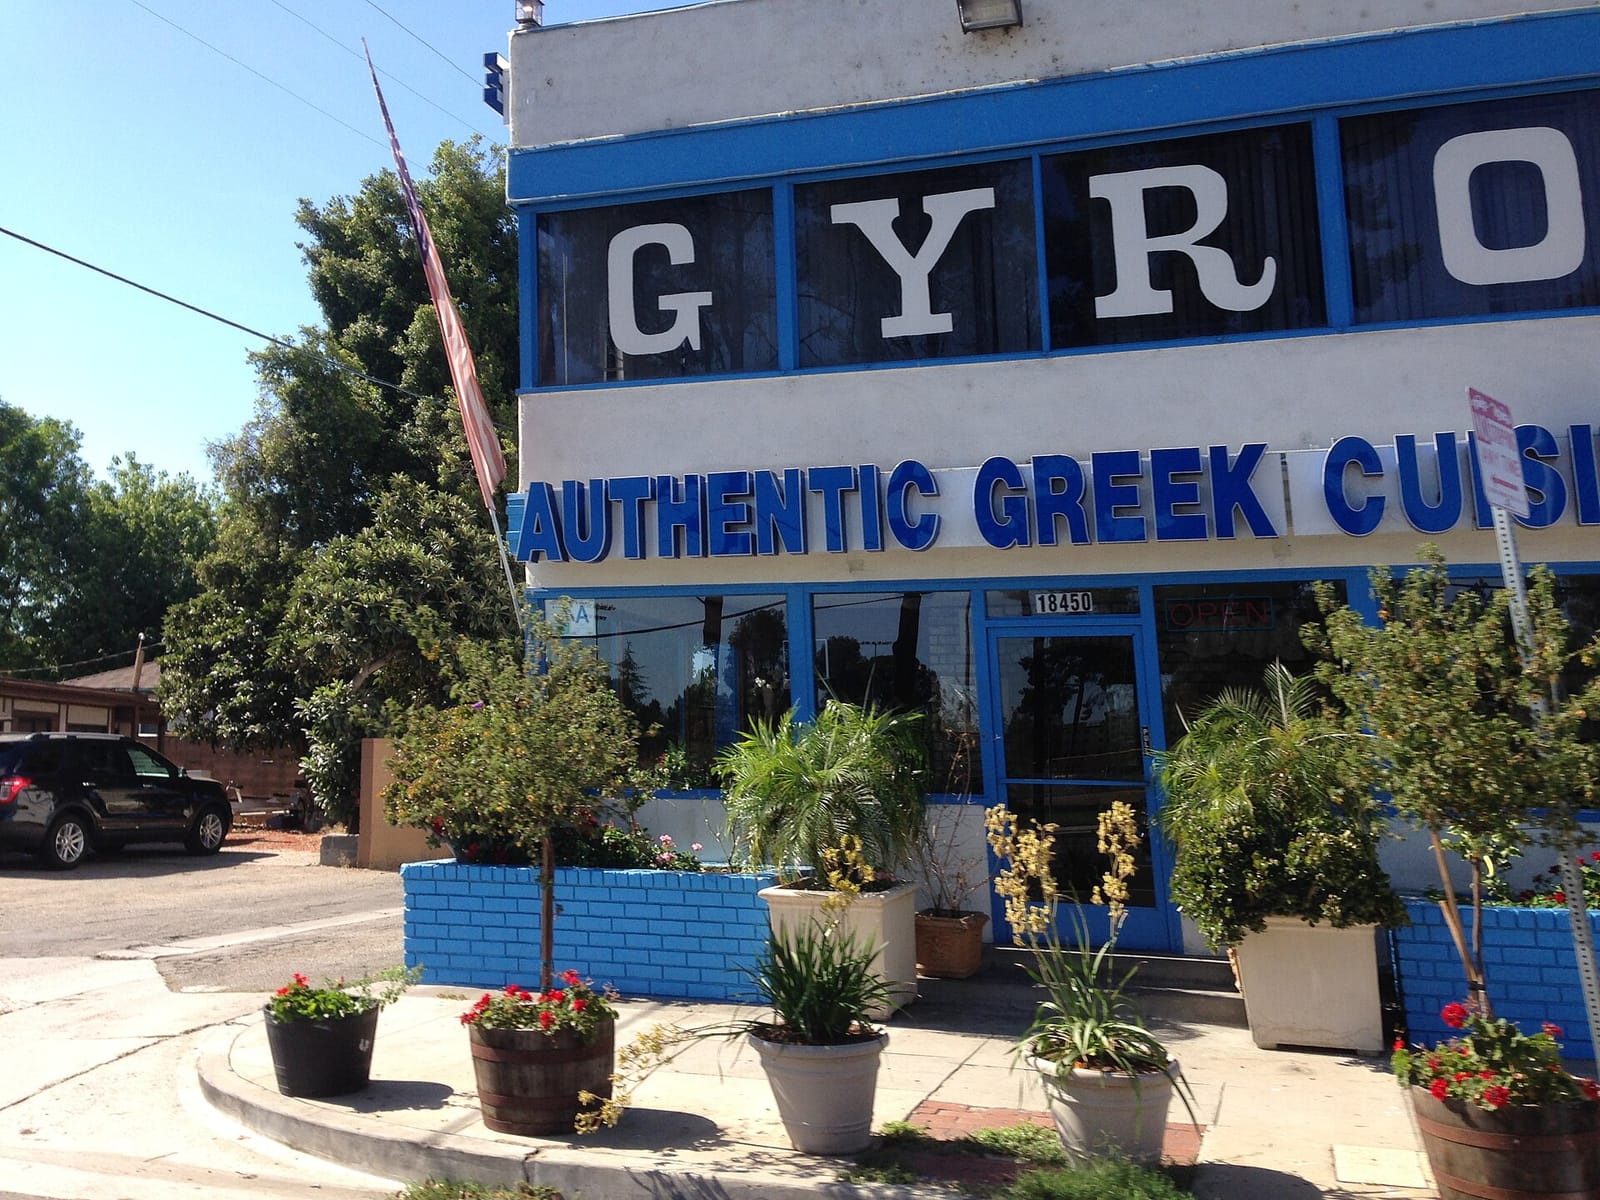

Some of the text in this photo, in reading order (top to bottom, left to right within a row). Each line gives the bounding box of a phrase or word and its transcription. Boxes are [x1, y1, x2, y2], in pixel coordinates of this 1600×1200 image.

[607, 126, 1586, 356] GYRO
[516, 458, 941, 564] AUTHENTIC
[973, 442, 1280, 550] GREEK
[1038, 593, 1091, 612] 18450
[1169, 602, 1269, 627] OPEN
